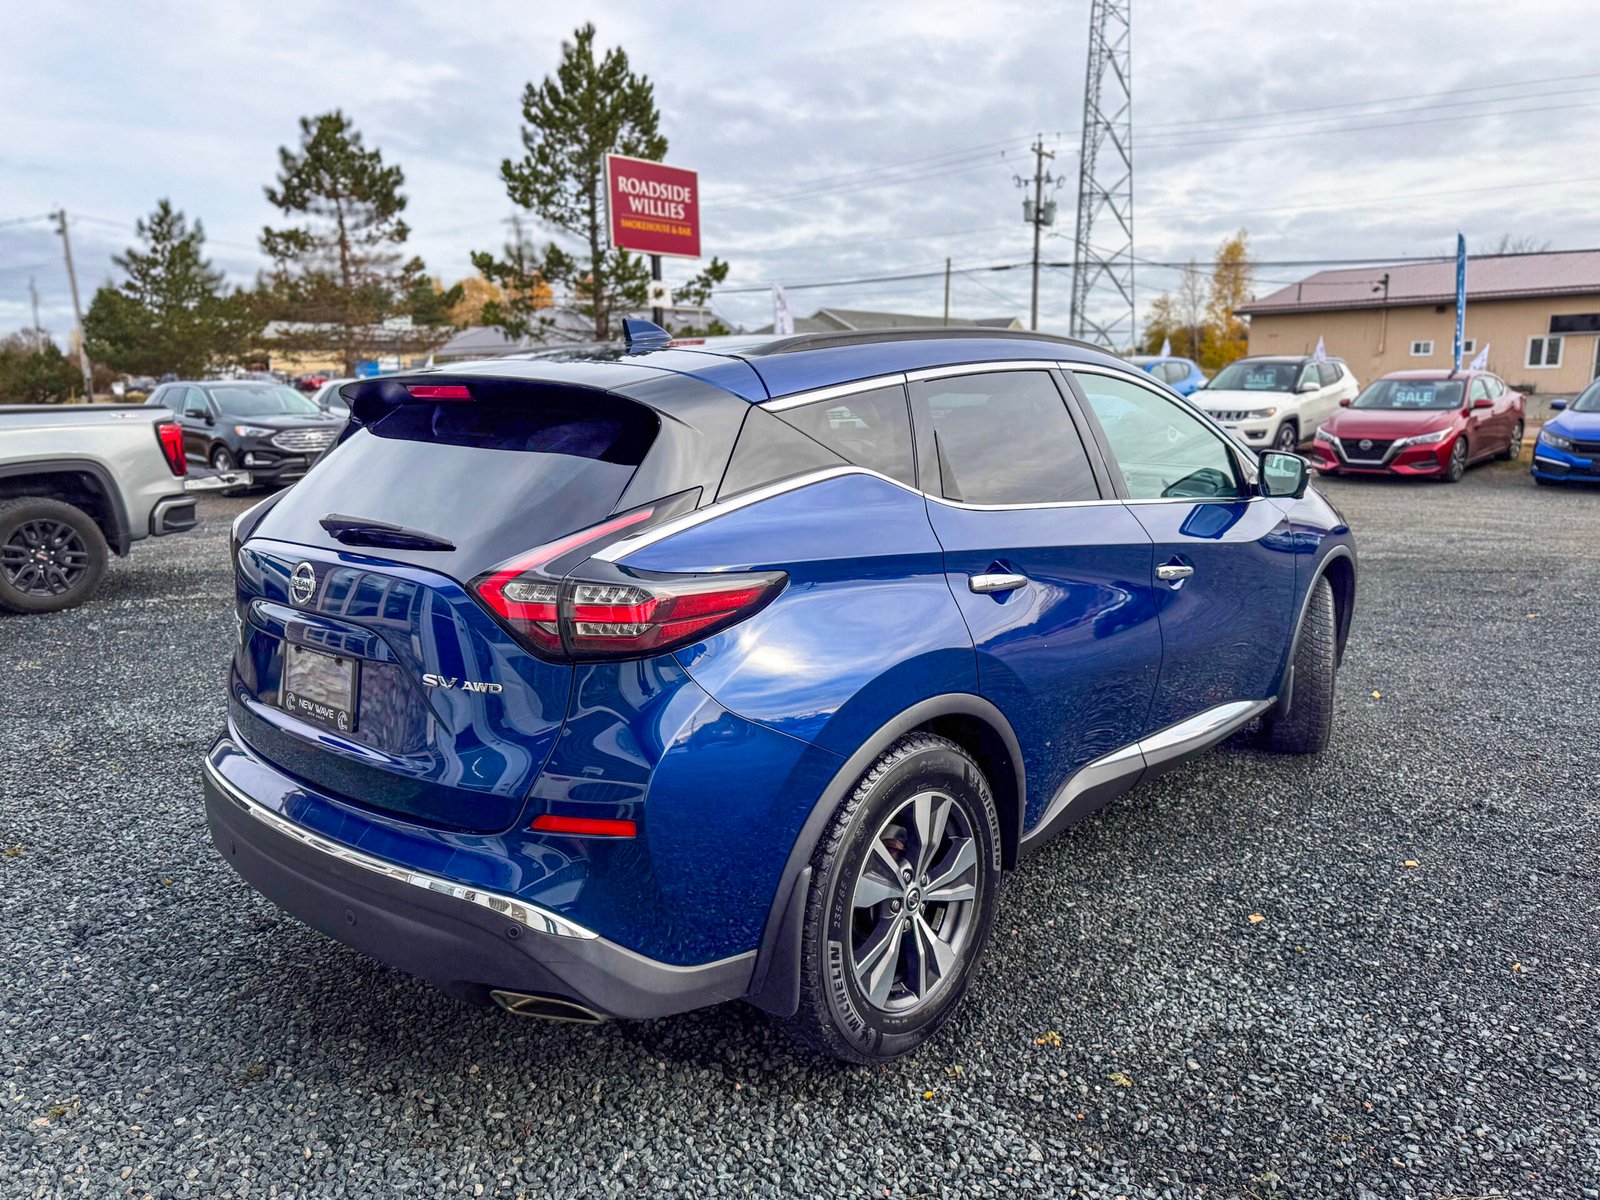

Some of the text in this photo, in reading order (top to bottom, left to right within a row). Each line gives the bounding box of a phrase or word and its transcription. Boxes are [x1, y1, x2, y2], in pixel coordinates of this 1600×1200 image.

[617, 176, 692, 203] ROADSIDE
[628, 196, 685, 219] WILLIES
[620, 218, 670, 234] SMOKEHOUSE
[678, 227, 692, 236] BAR
[1246, 374, 1273, 383] SALE
[1396, 391, 1433, 402] SALE
[422, 673, 503, 694] SV AWD
[298, 698, 334, 719] NEW WAVE
[981, 788, 1000, 867] MICHELIN
[834, 880, 848, 929] 235/65
[830, 946, 861, 1033] MICHELIN
